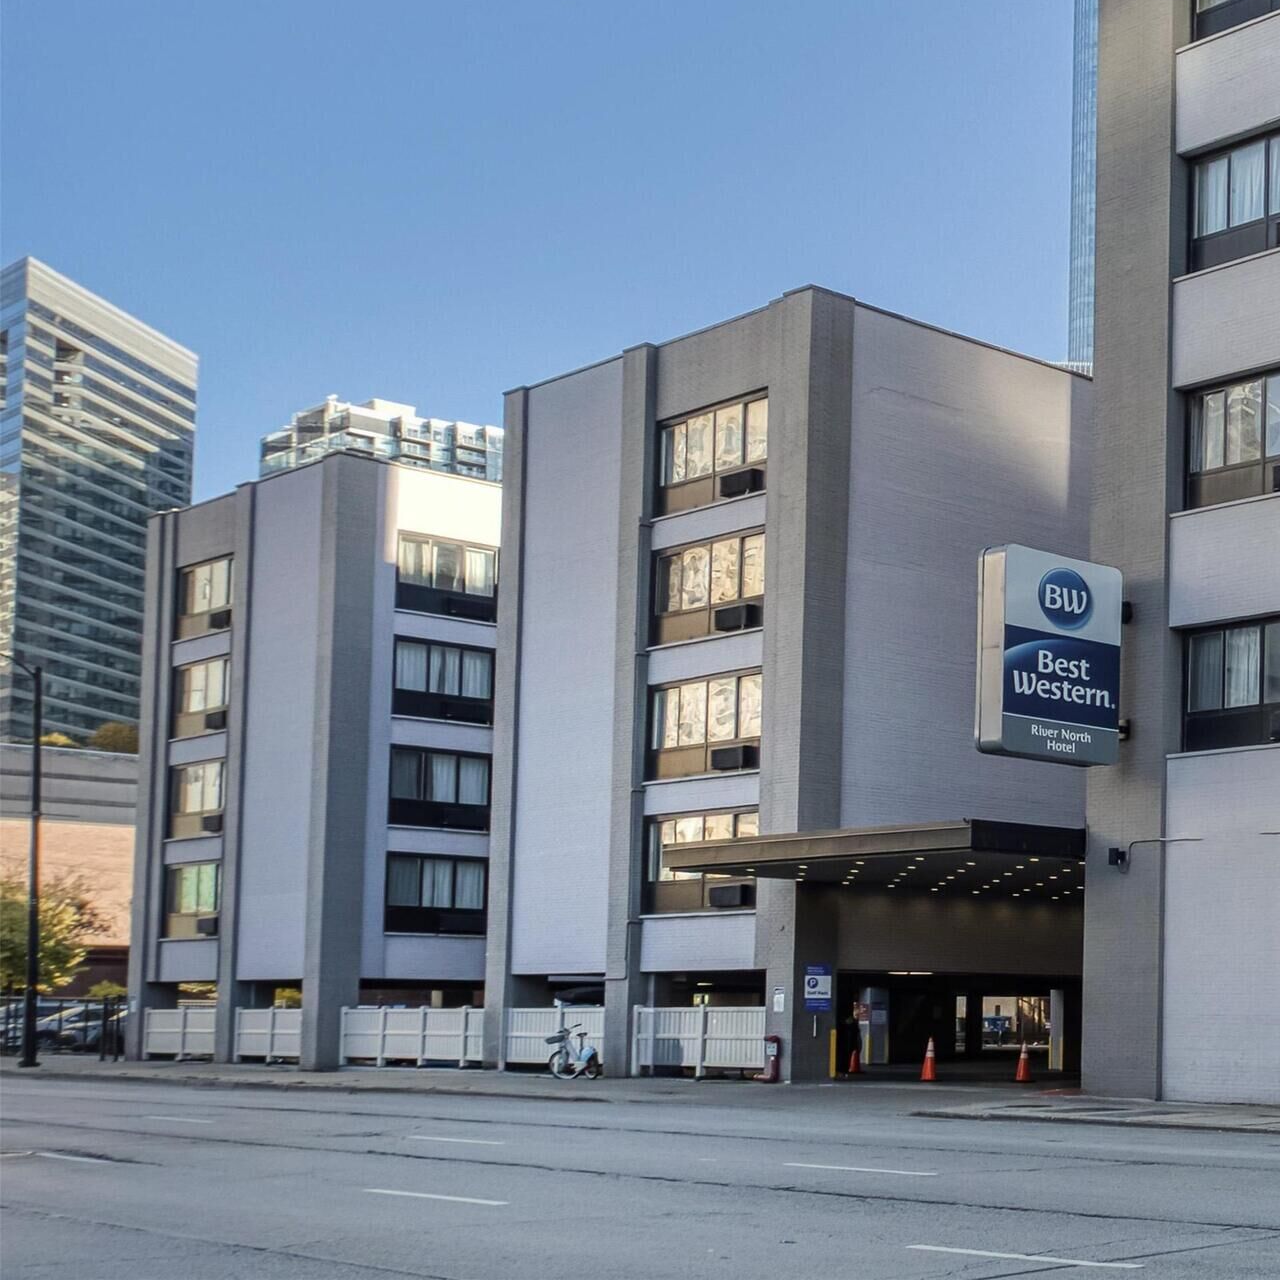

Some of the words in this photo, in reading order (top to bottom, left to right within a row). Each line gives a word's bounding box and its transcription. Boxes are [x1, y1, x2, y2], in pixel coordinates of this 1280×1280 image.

[1044, 583, 1087, 615] BW
[1037, 649, 1090, 681] Best
[1031, 724, 1058, 738] River
[1061, 728, 1092, 743] North
[1046, 740, 1076, 753] Hotel
